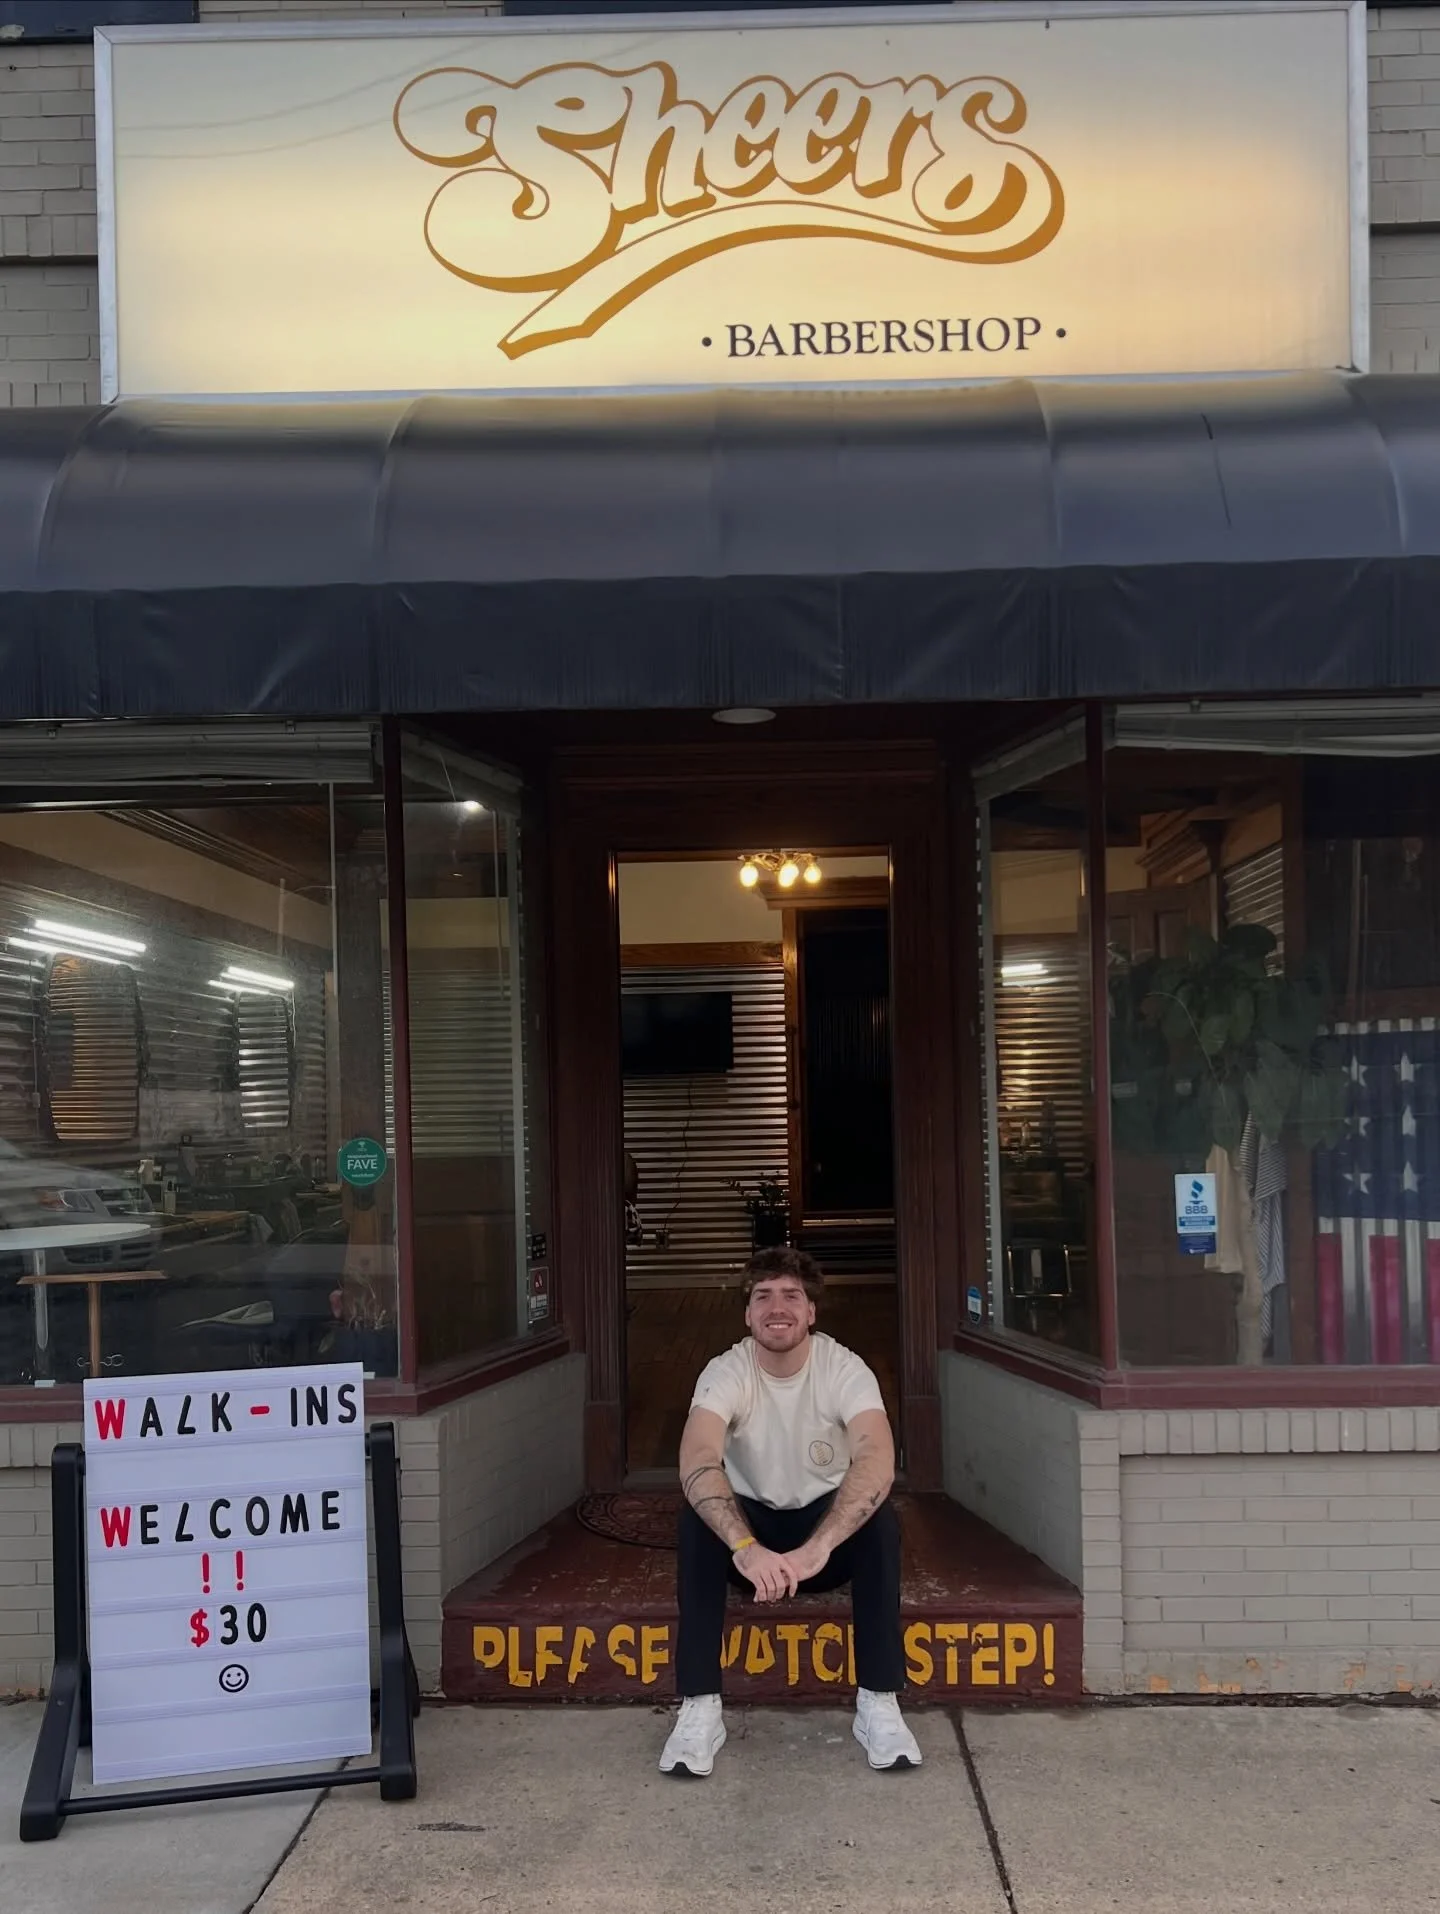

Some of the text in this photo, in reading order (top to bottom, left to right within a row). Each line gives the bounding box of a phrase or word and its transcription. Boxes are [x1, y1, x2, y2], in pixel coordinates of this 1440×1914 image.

[393, 60, 1065, 361] Sheers
[725, 317, 1042, 358] BARBERSHOP
[347, 1158, 378, 1170] FAVE
[1184, 1205, 1209, 1215] BBB
[100, 1490, 340, 1548] WELCOME
[189, 1602, 268, 1648] $30
[903, 1622, 1056, 1686] STEP!
